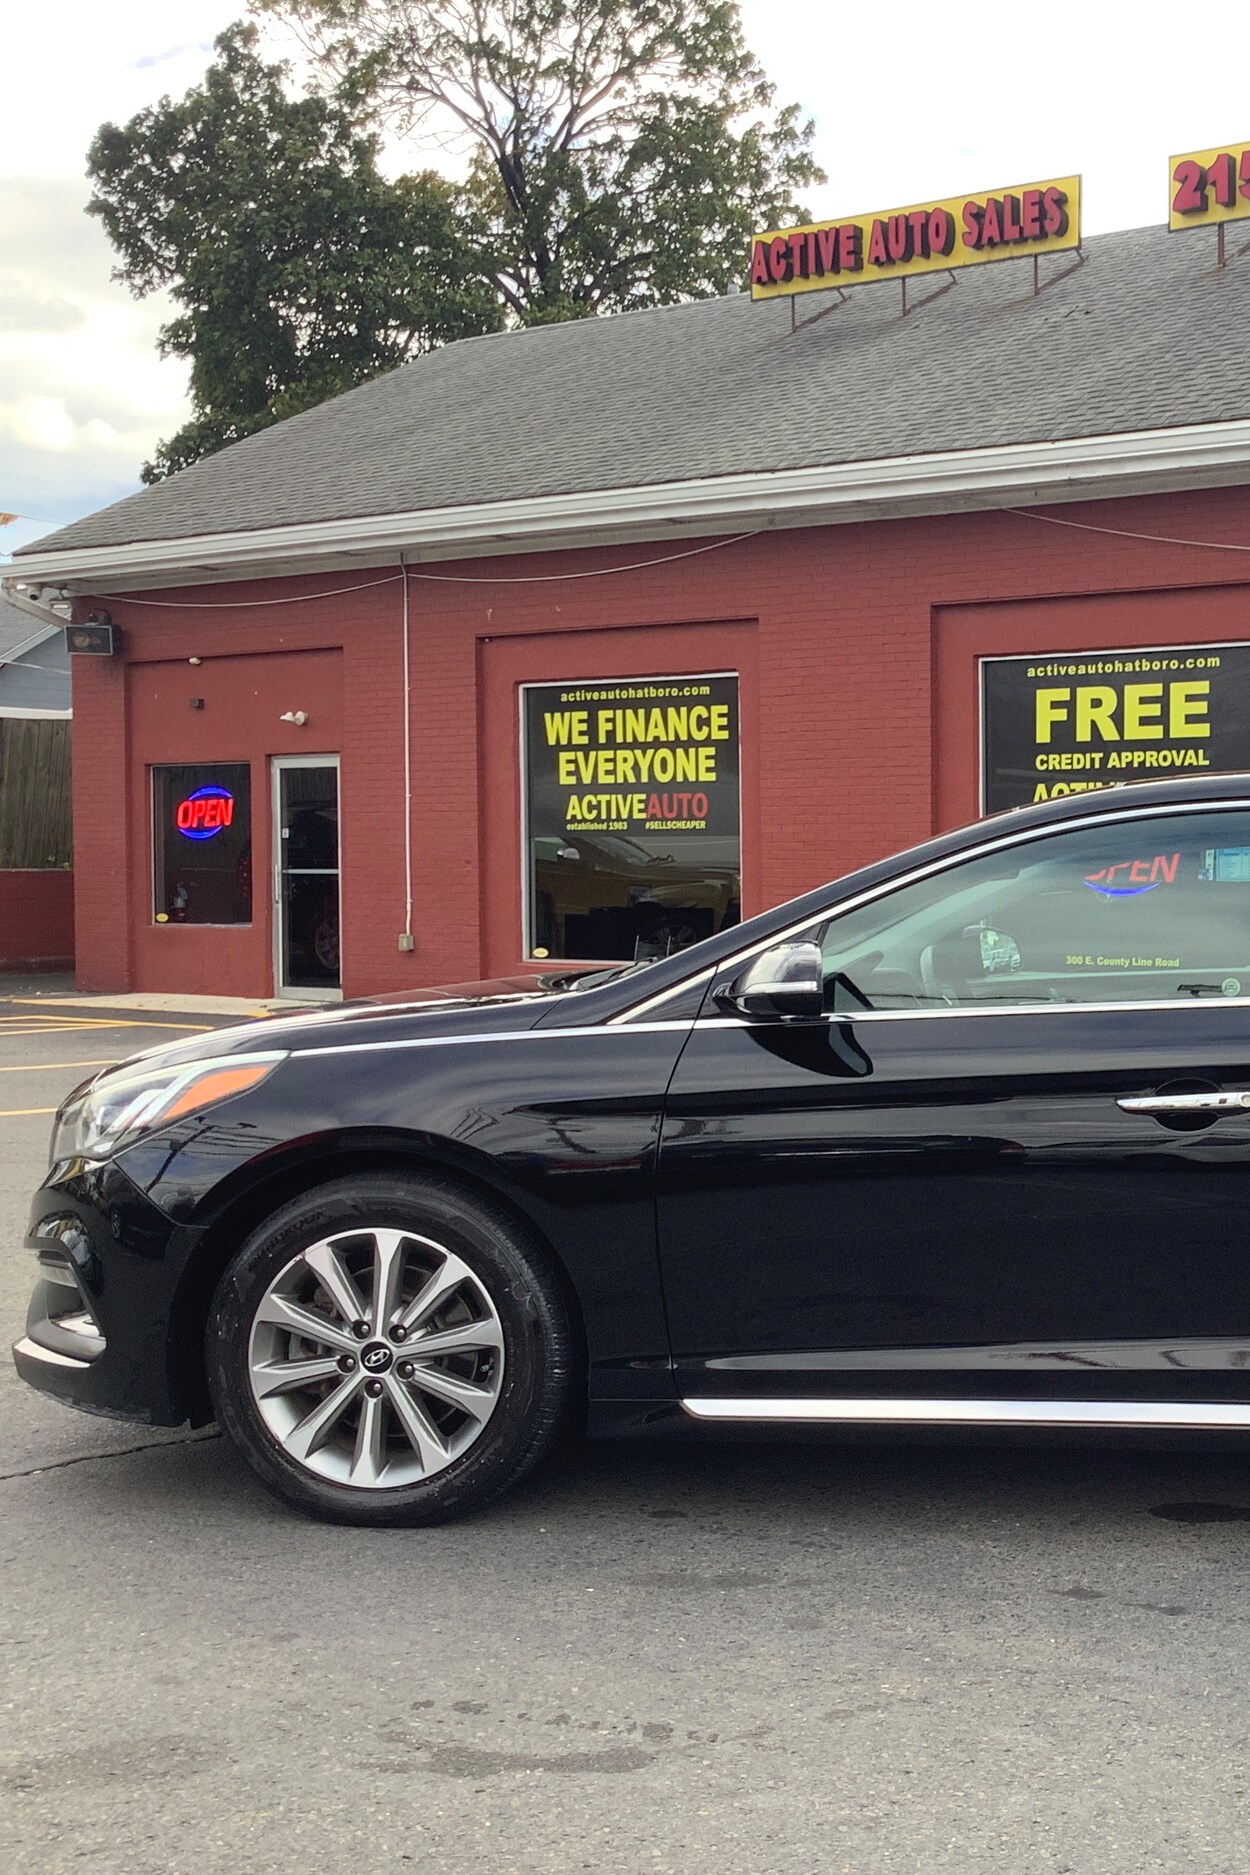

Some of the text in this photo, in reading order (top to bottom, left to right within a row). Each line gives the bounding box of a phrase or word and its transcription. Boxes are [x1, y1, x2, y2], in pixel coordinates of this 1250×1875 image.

[751, 187, 1069, 286] ACTIVE AUTO SALES
[1026, 655, 1221, 678] activeautohatboro.com
[560, 684, 711, 703] activeautohatboro.com
[1035, 680, 1211, 744] FREE
[543, 704, 730, 746] WE FINANCE
[558, 746, 717, 785] EVERYONE
[1035, 749, 1210, 771] CREDIT APPROVAL
[176, 798, 235, 829] OPEN
[645, 820, 706, 830] #SELLSCHEAPER
[565, 821, 628, 831] established 1983
[1065, 955, 1180, 968] 300 E. County Line Road
